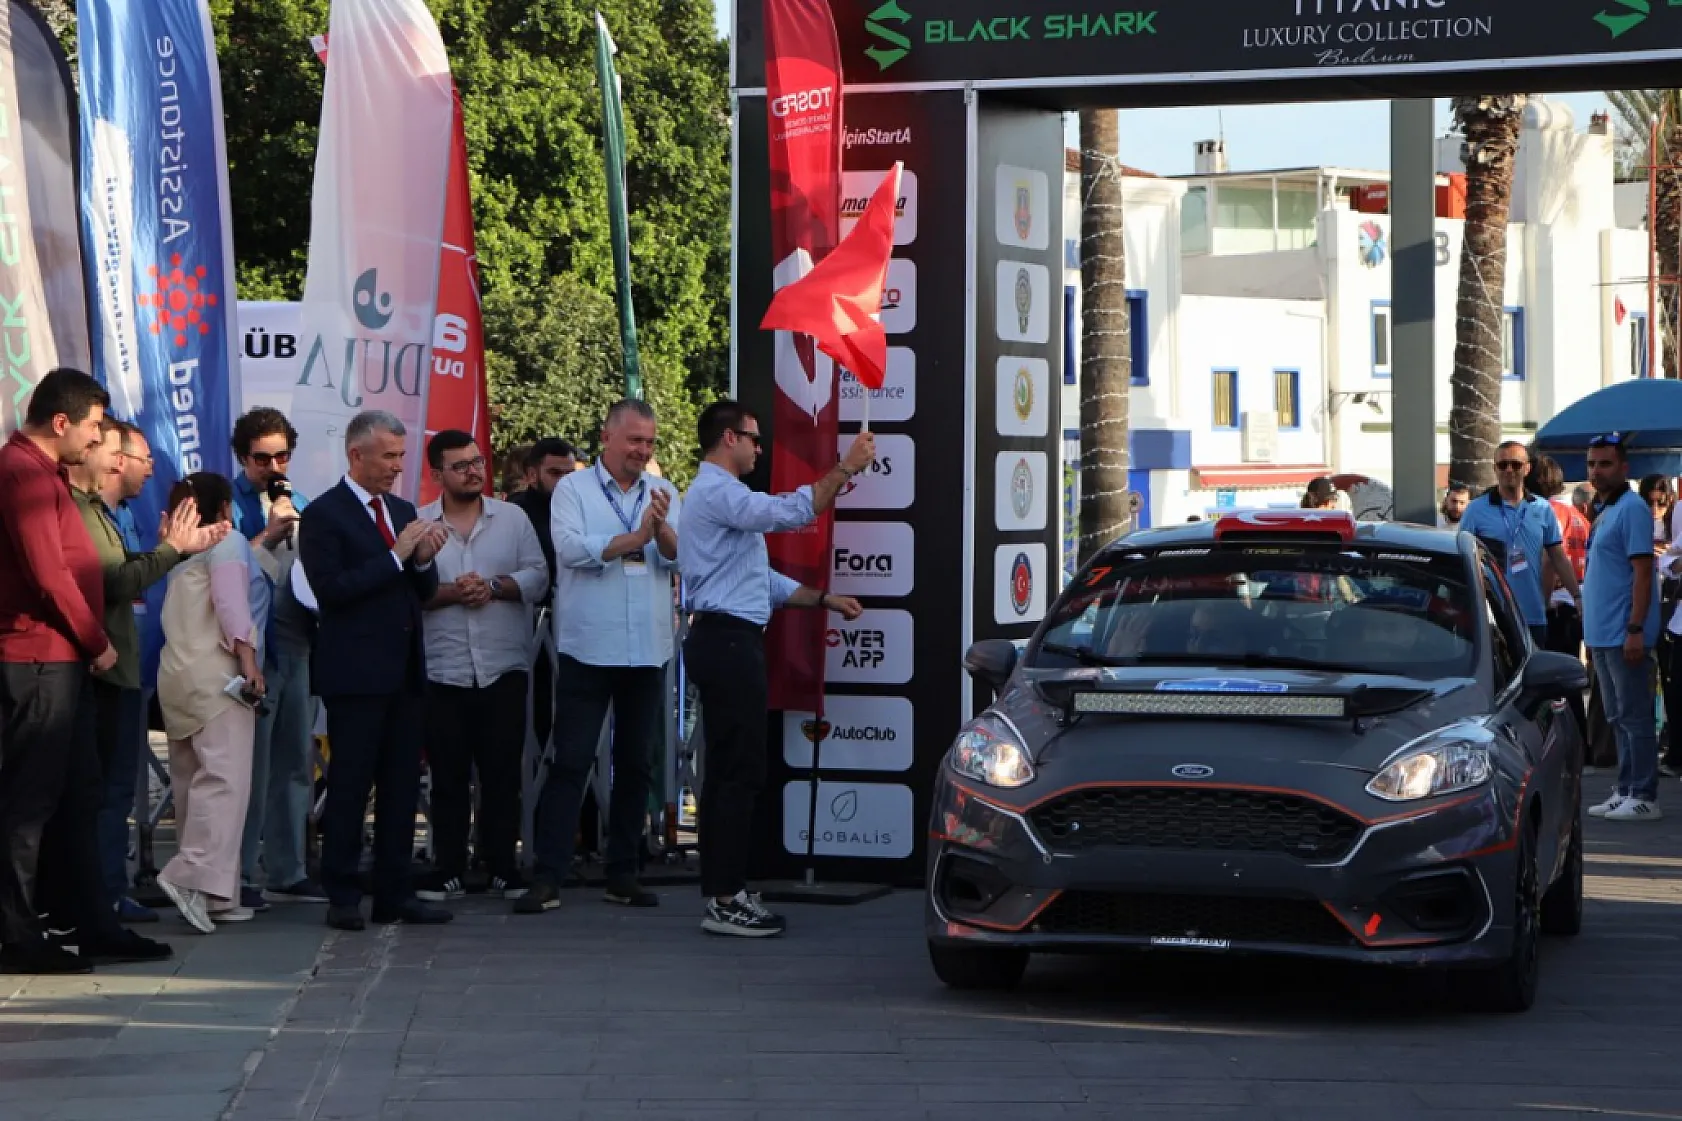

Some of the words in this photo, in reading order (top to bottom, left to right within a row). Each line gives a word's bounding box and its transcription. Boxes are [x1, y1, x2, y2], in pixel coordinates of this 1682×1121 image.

[924, 16, 1031, 43] BLACK
[1043, 11, 1158, 40] SHARK
[1243, 24, 1331, 48] LUXURY
[1338, 16, 1492, 43] COLLECTION
[1312, 47, 1415, 66] Bodrum
[238, 327, 297, 359] ÜB
[834, 548, 893, 572] Fora
[1086, 566, 1112, 586] 7
[825, 628, 885, 648] OWER
[841, 649, 885, 669] APP
[831, 725, 897, 742] AutoClub
